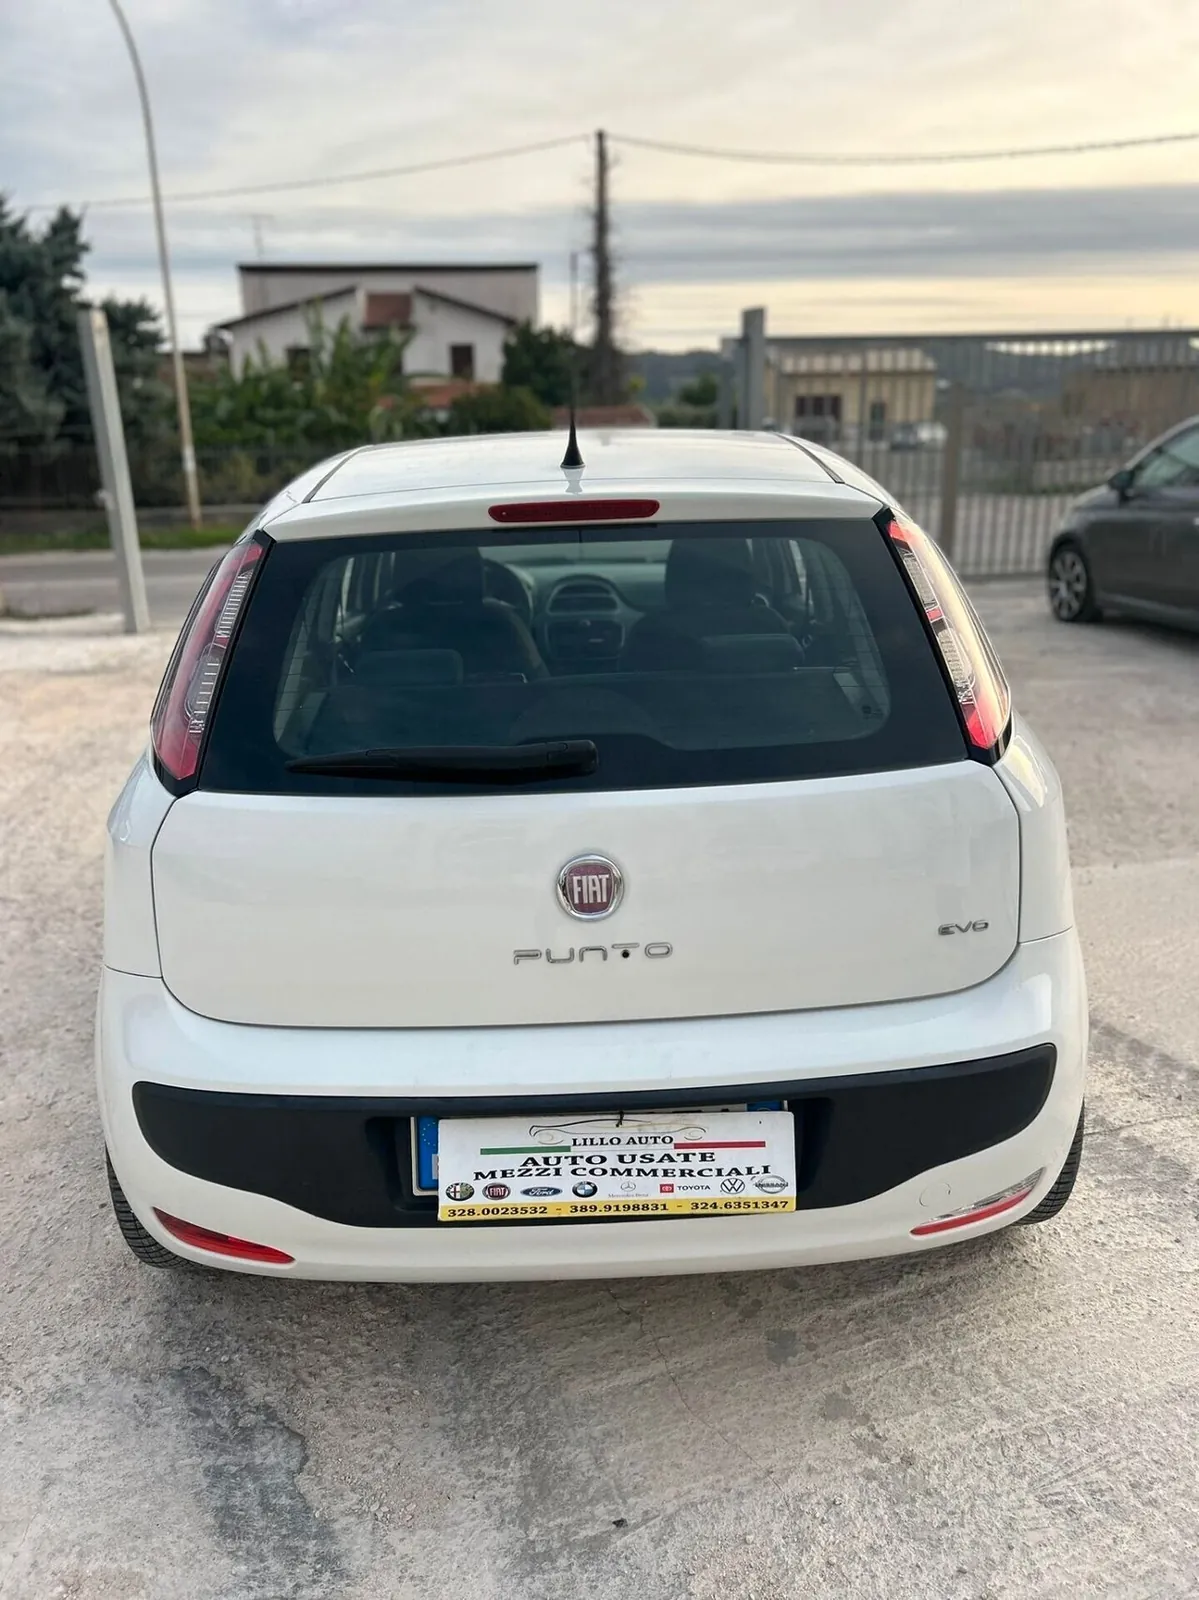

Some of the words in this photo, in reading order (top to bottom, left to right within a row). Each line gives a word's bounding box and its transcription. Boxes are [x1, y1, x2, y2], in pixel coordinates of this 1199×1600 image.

[572, 874, 609, 904] FIAT
[938, 919, 989, 936] EVO
[513, 942, 673, 965] PUNTO
[572, 1137, 621, 1146] LILLO
[626, 1136, 674, 1146] AUTO
[520, 1155, 607, 1167] AUTO
[617, 1152, 715, 1164] USATE
[474, 1168, 563, 1180] MEZZI
[571, 1165, 771, 1177] COMMERCIALI
[489, 1187, 506, 1196] FIAT
[528, 1187, 556, 1197] Ford
[448, 1206, 547, 1217] 328.0023532
[570, 1203, 668, 1213] 389.9198831
[691, 1200, 788, 1210] 324.6351347
